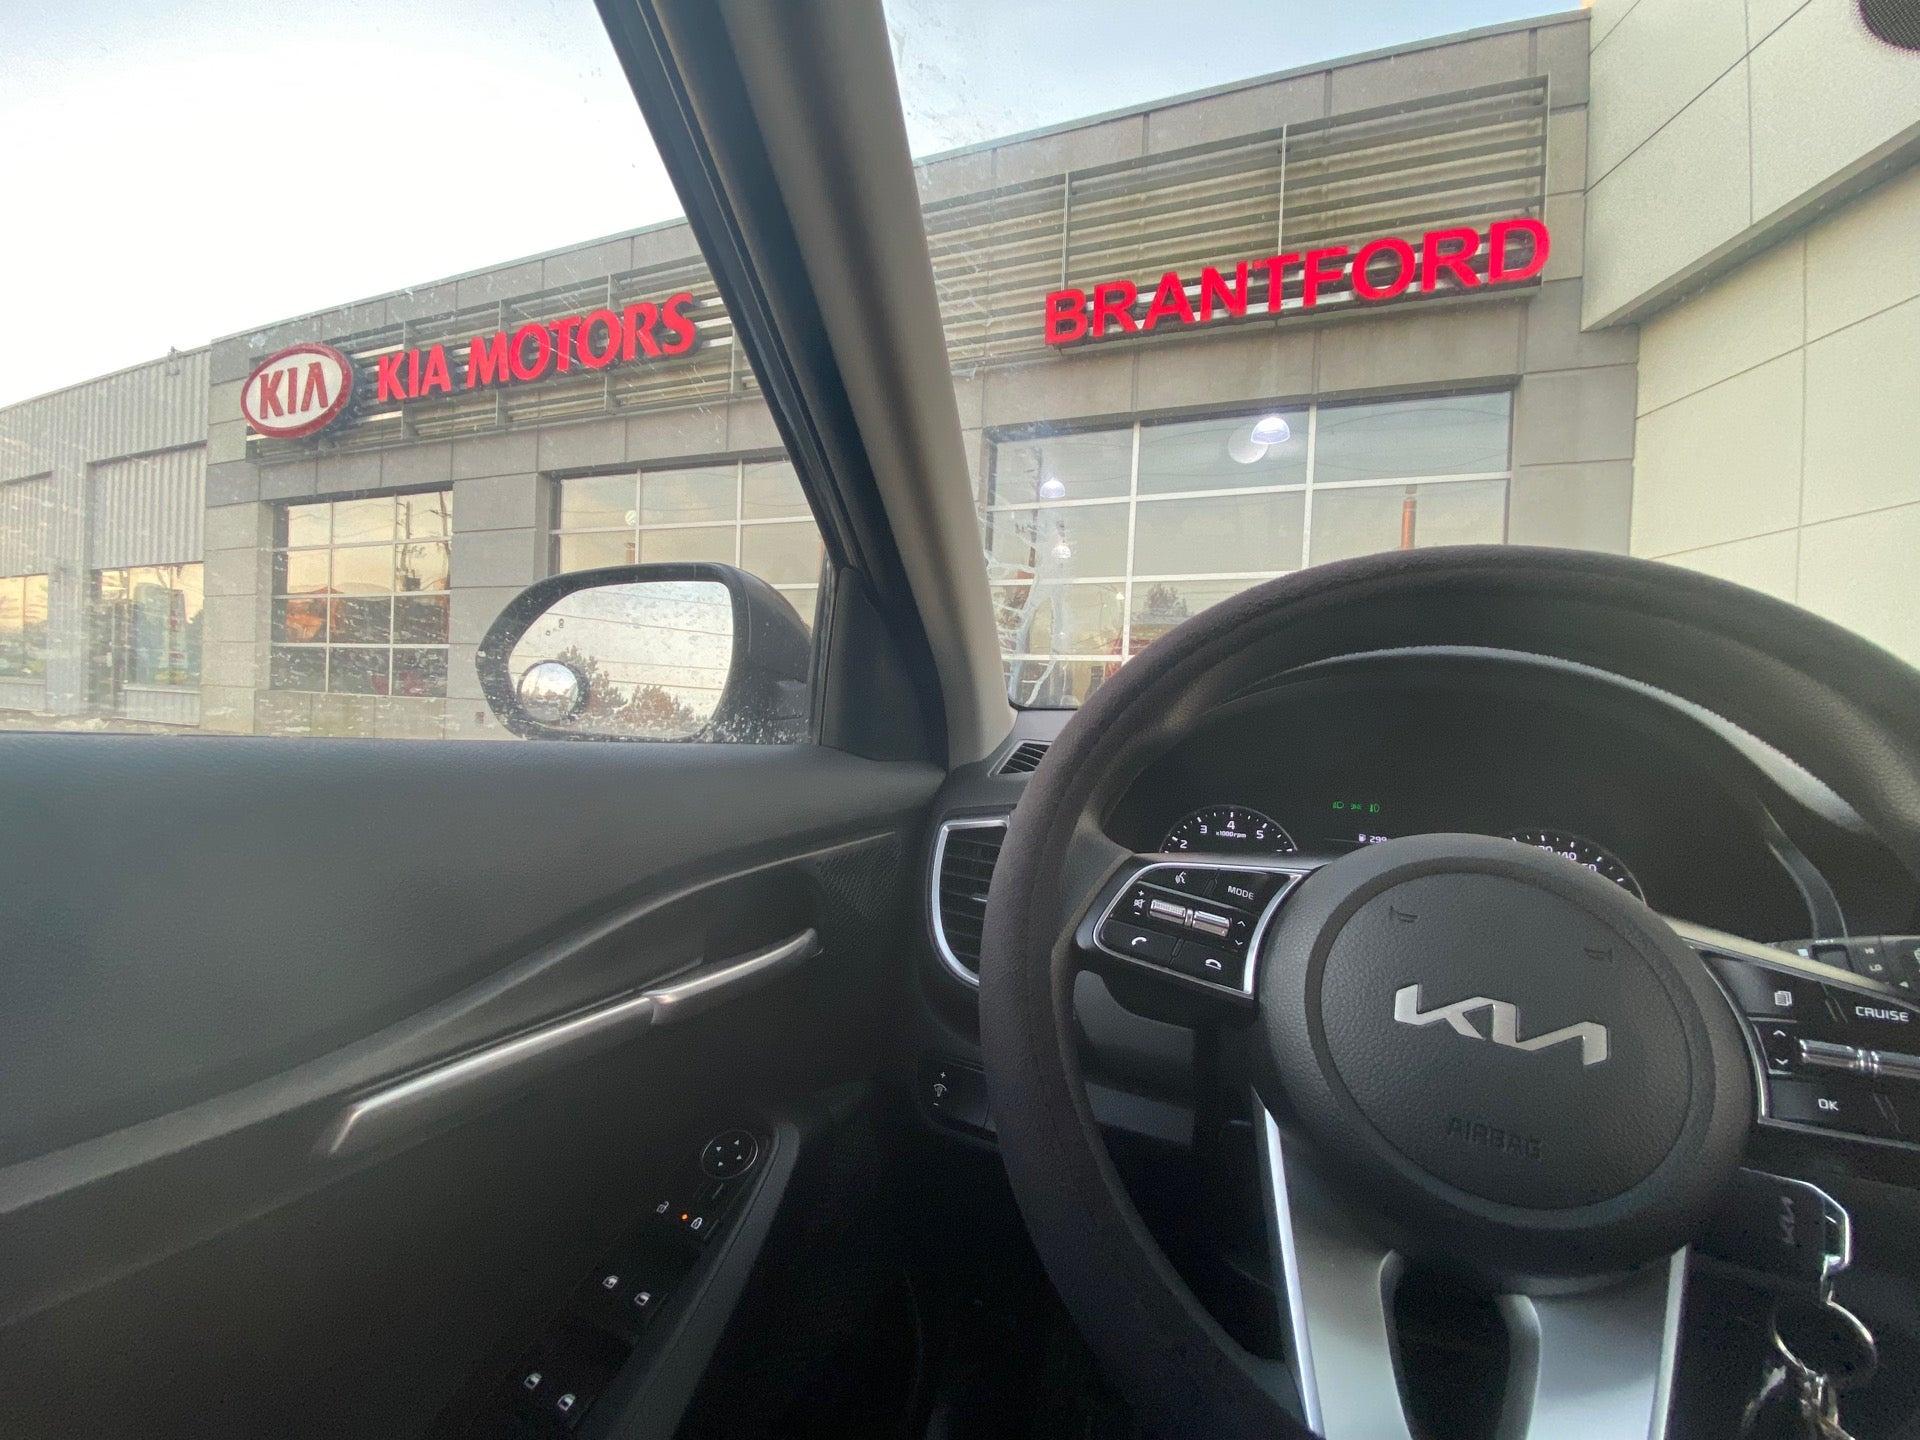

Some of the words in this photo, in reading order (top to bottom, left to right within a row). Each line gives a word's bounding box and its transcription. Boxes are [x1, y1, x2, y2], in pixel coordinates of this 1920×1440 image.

[1044, 217, 1551, 346] BRANTFORD
[377, 343, 452, 403] KIA
[466, 292, 697, 390] MOTORS
[259, 361, 329, 420] KIA
[1200, 824, 1208, 834] 3
[1226, 820, 1235, 830] 4
[1256, 830, 1265, 840] 5
[1179, 839, 1188, 849] 2
[1227, 885, 1255, 901] MODE
[1855, 1005, 1910, 1023] CRUISE
[1393, 984, 1609, 1066] KIA
[1817, 1097, 1840, 1111] OK
[1447, 1117, 1542, 1159] AIRBAG
